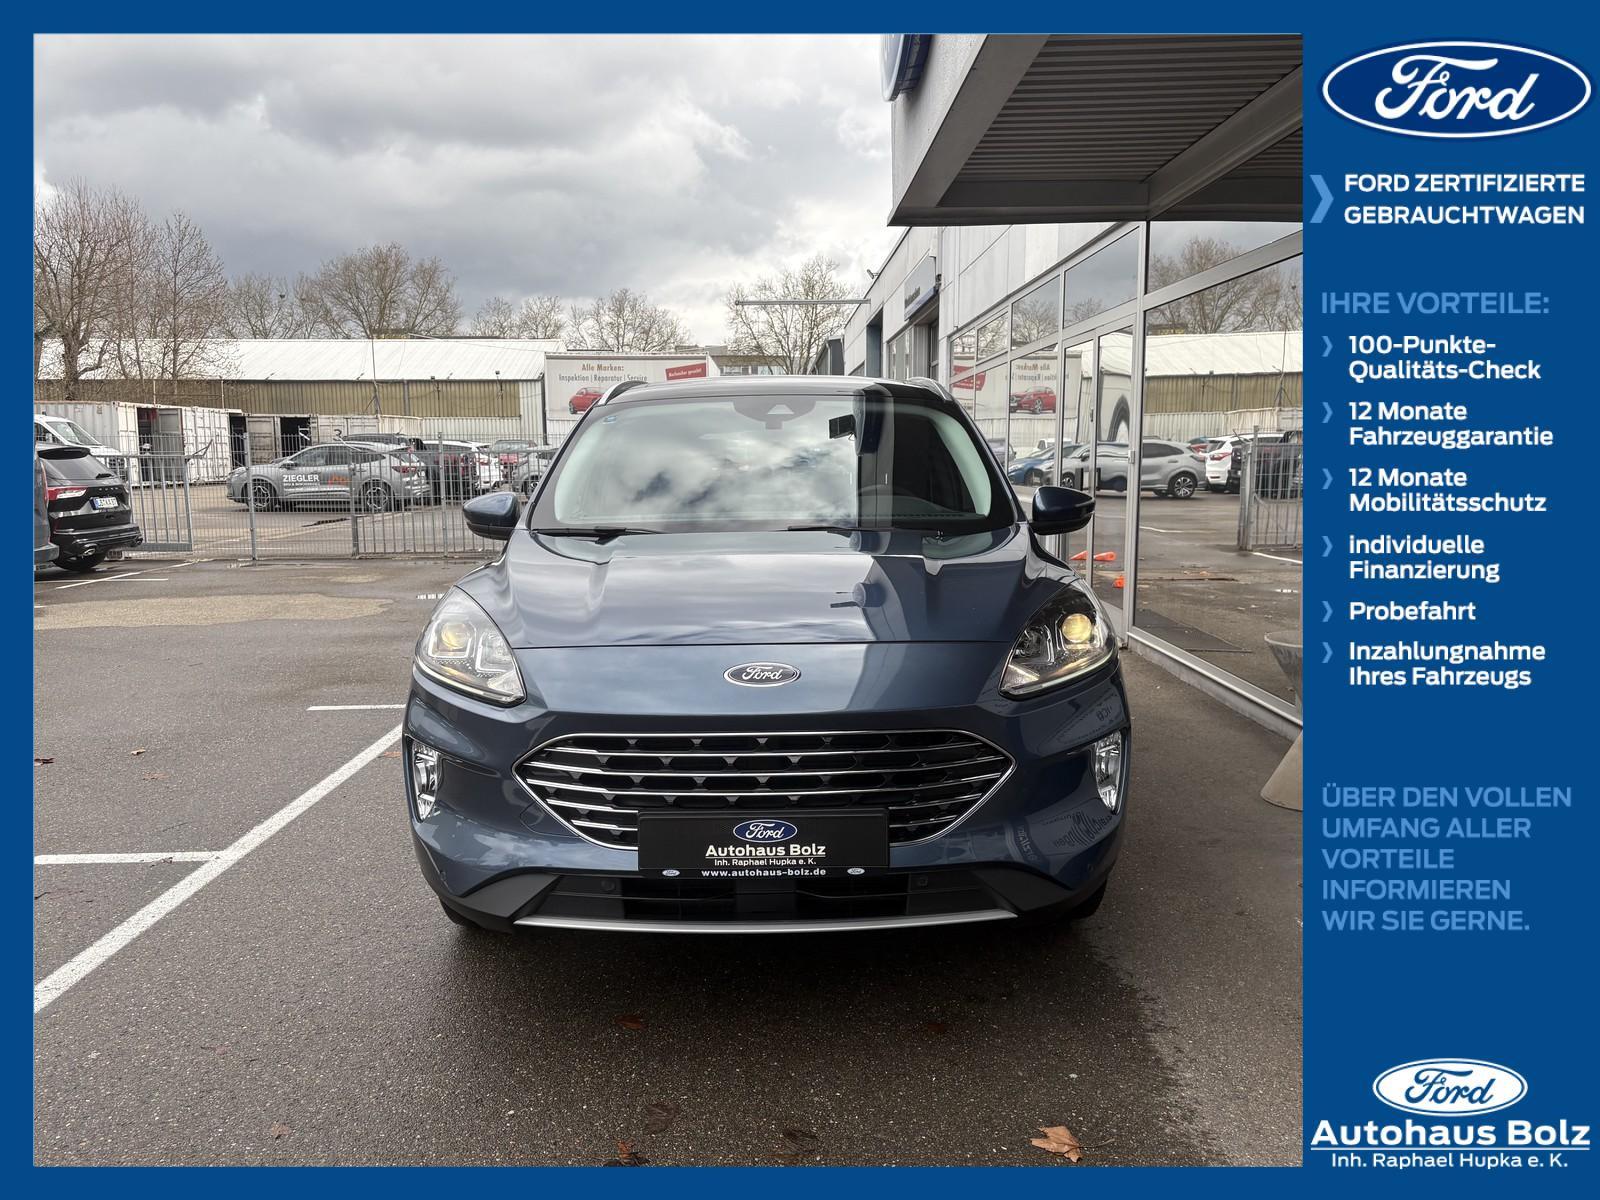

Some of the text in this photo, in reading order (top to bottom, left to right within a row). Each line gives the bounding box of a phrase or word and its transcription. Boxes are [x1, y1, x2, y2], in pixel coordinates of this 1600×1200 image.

[597, 363, 624, 371] Marken:
[559, 374, 589, 382] Inspektion
[594, 374, 621, 382] Reparatur
[282, 474, 320, 482] ZIEGLER
[742, 666, 782, 680] Ford
[745, 823, 784, 839] Ford
[705, 844, 826, 857] Autohaus Bolz
[732, 858, 768, 867] Raphael
[769, 858, 796, 867] Hupka
[701, 868, 827, 877] www.autohaus-bolz.de
